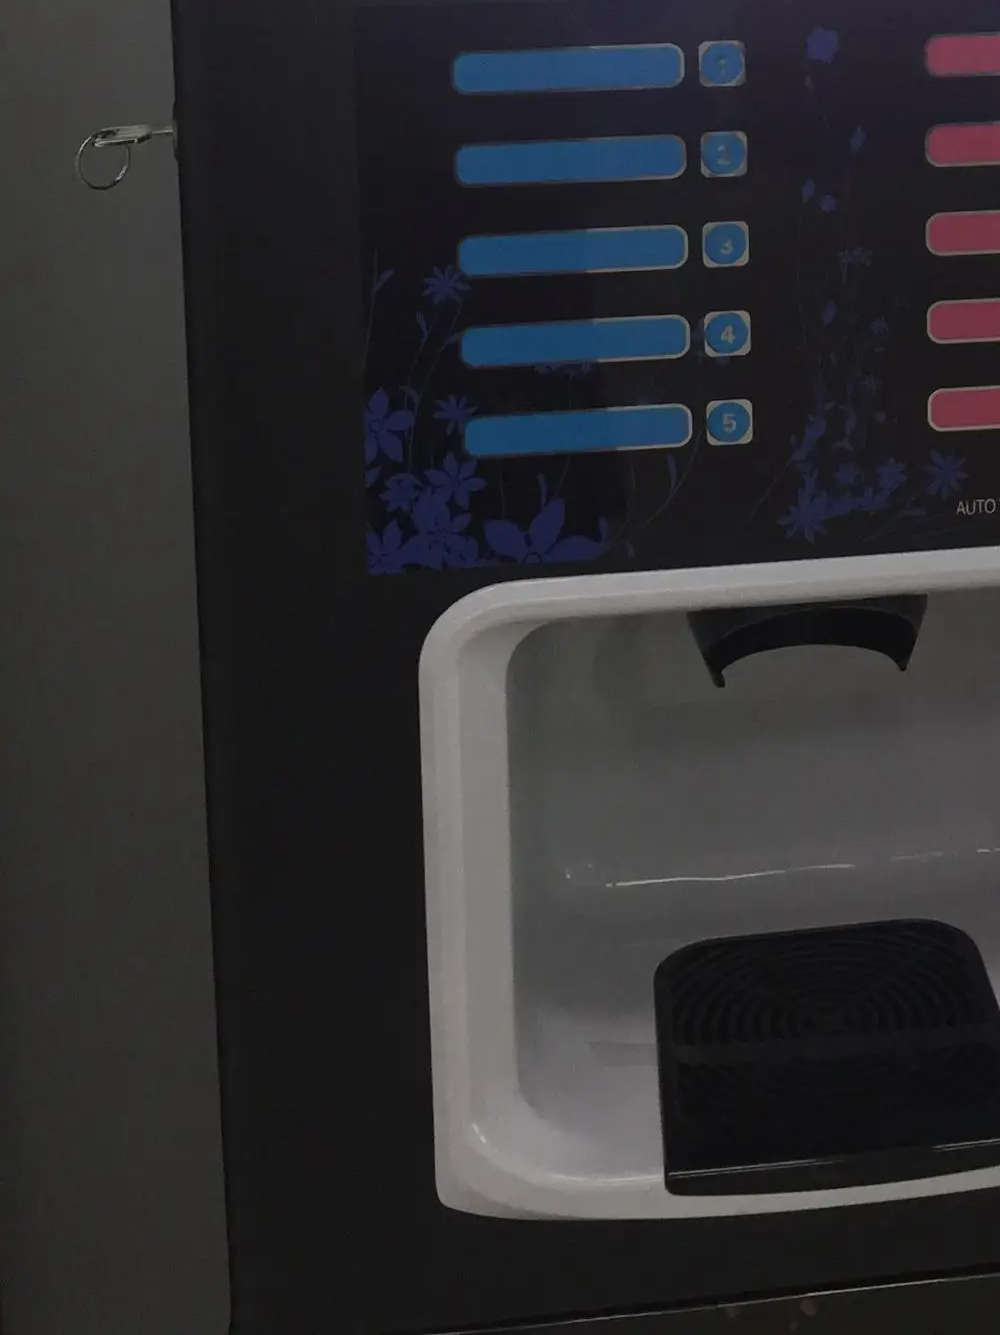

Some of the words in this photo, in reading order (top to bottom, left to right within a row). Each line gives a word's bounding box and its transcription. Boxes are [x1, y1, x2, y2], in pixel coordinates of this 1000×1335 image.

[717, 145, 731, 165] 2
[719, 235, 734, 255] 3
[720, 325, 736, 345] 4
[722, 412, 737, 433] 5
[956, 498, 996, 516] AUTO
